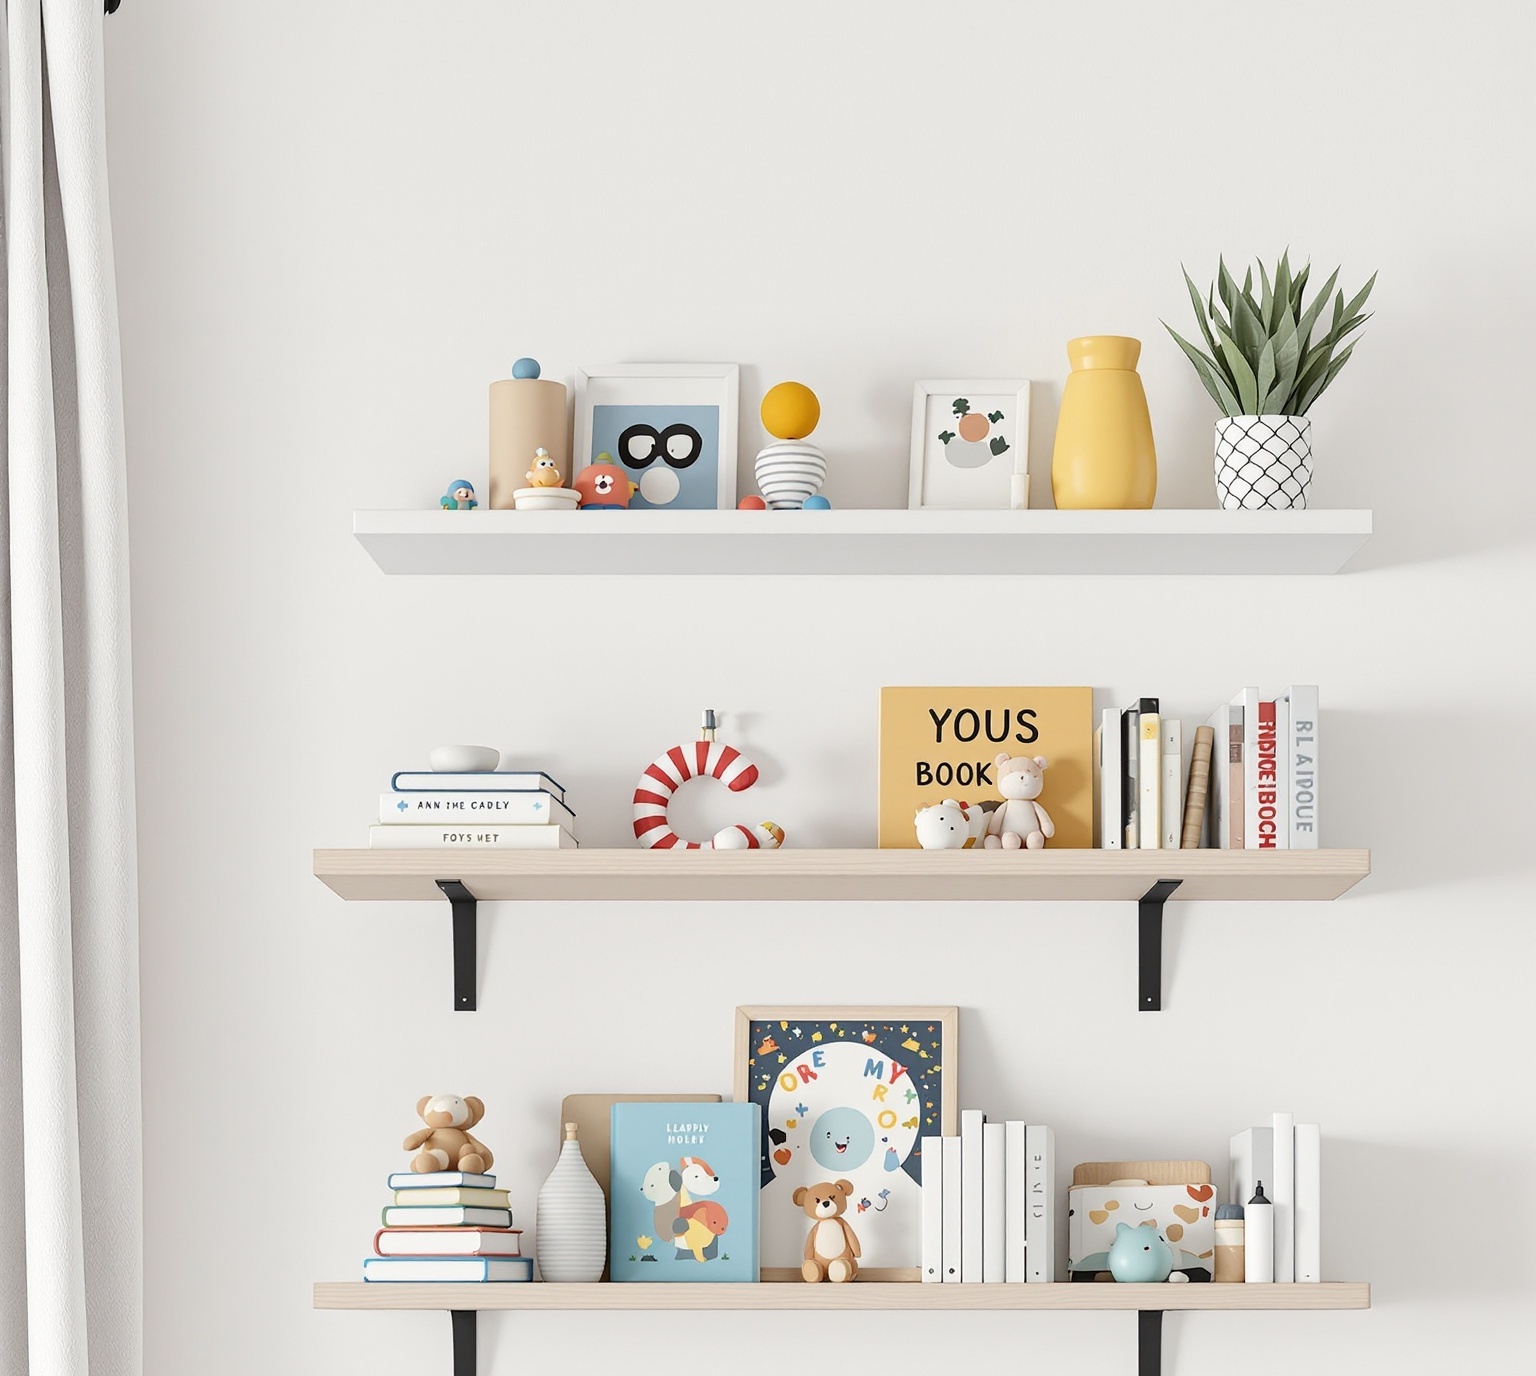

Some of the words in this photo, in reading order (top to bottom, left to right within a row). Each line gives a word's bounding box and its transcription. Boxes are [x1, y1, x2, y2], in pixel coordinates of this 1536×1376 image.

[928, 708, 1040, 744] YOUS
[916, 761, 993, 787] BOOK
[417, 801, 441, 810] ANN
[779, 1050, 826, 1093] ORE
[863, 1058, 909, 1086] MY
